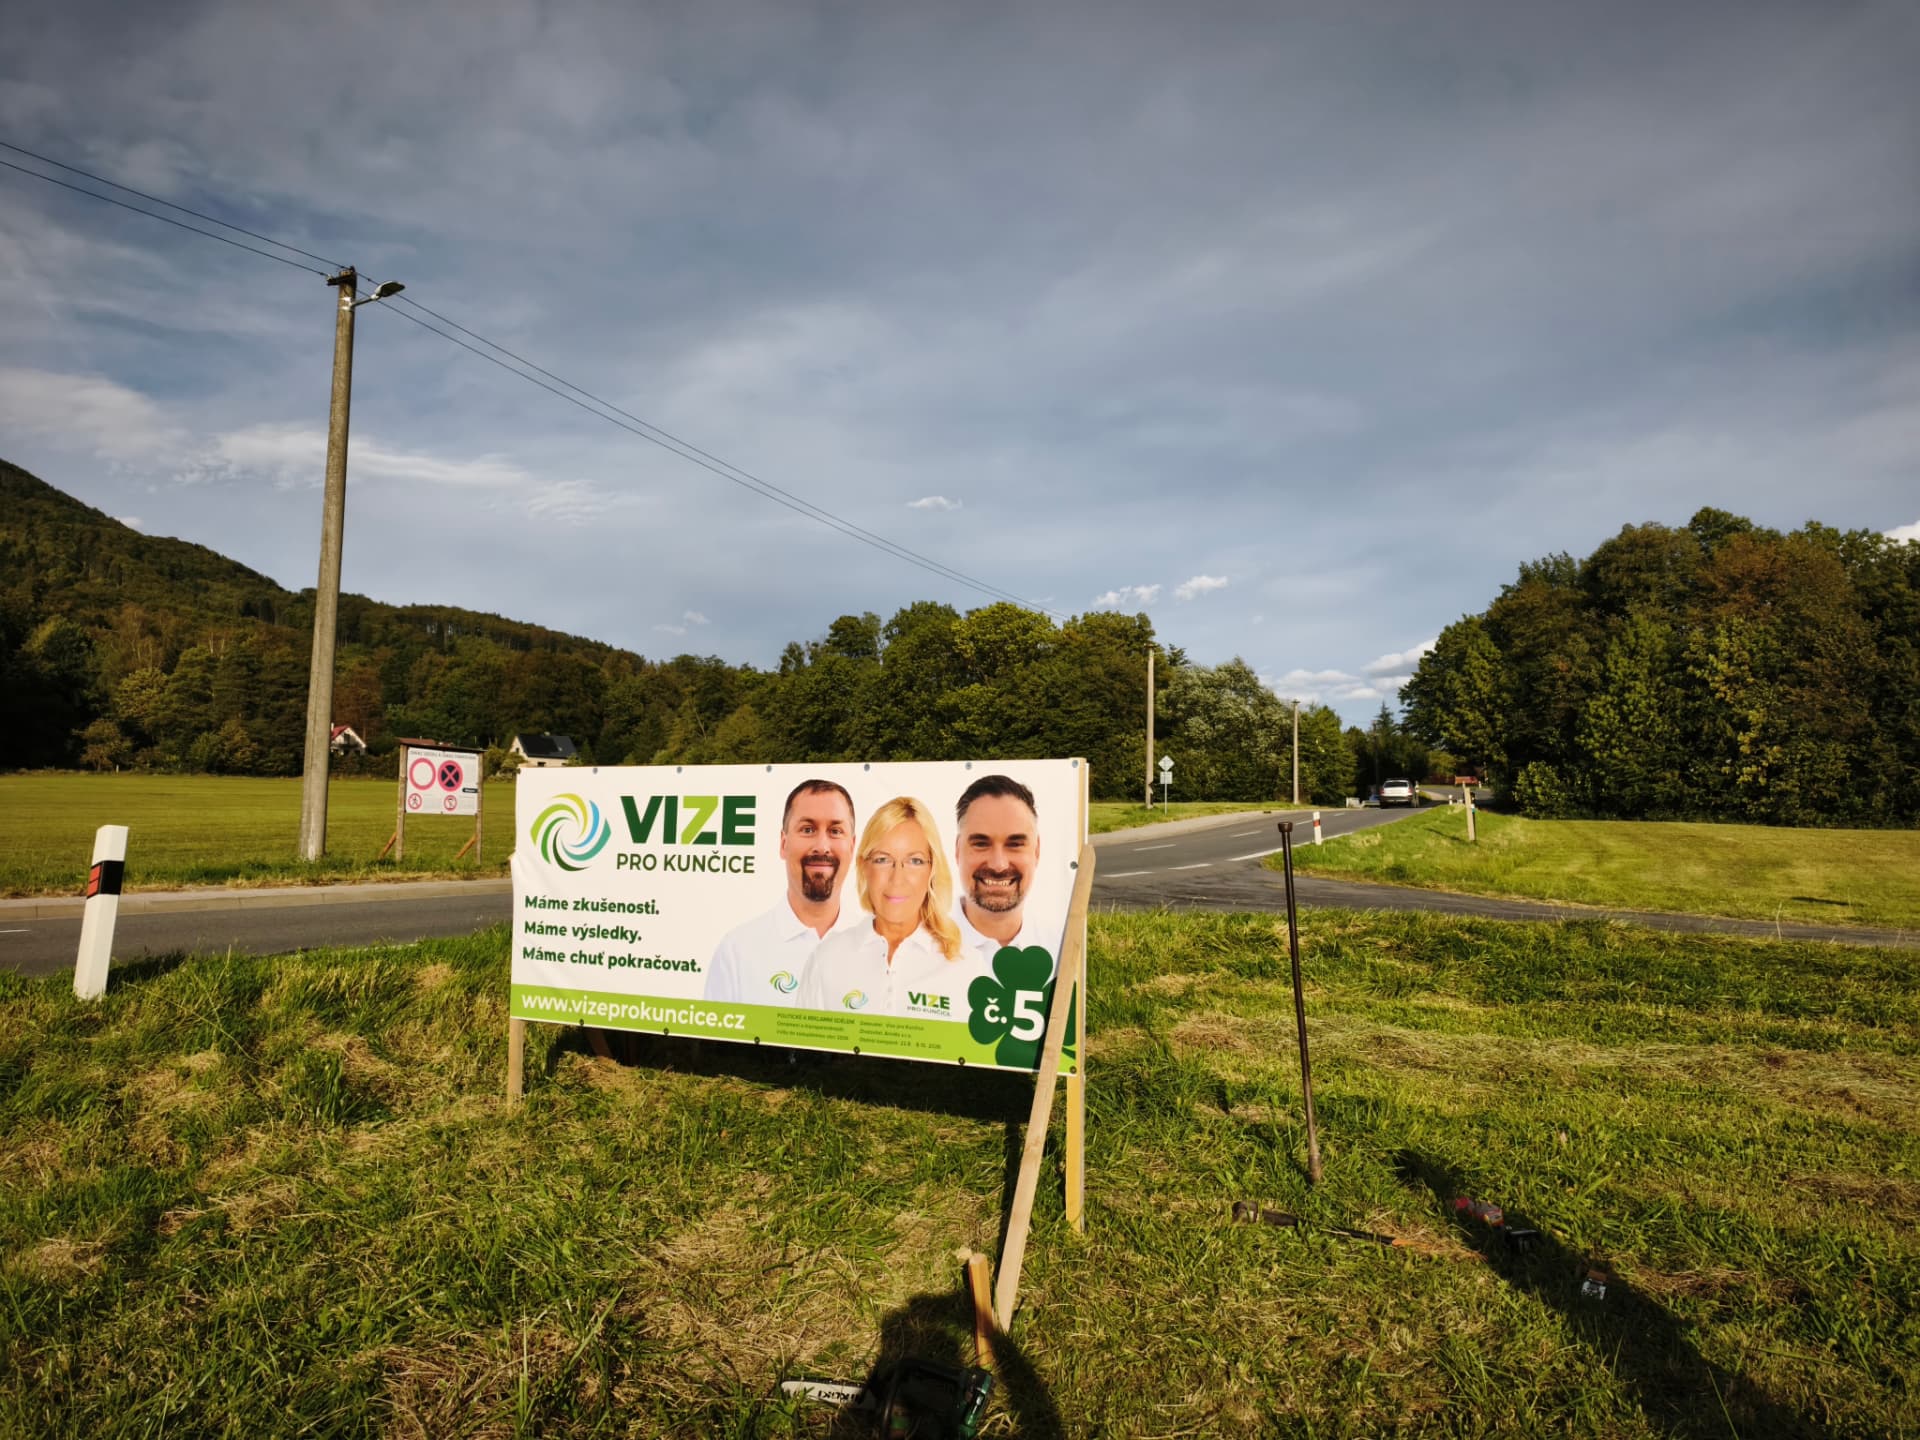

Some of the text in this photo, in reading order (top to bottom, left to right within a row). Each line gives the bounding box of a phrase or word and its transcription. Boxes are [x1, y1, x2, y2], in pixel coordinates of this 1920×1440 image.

[620, 795, 756, 845] VIZE
[616, 850, 755, 873] PRO KUNČICE
[524, 895, 660, 915] Máme zkušenosti.
[524, 921, 642, 944] Máme výsledky.
[522, 946, 702, 973] Máme chuť pokračovat.
[522, 994, 745, 1030] www.vizeprokuncice.cz
[908, 991, 950, 1010] VIZE
[984, 990, 1045, 1041] č. 5
